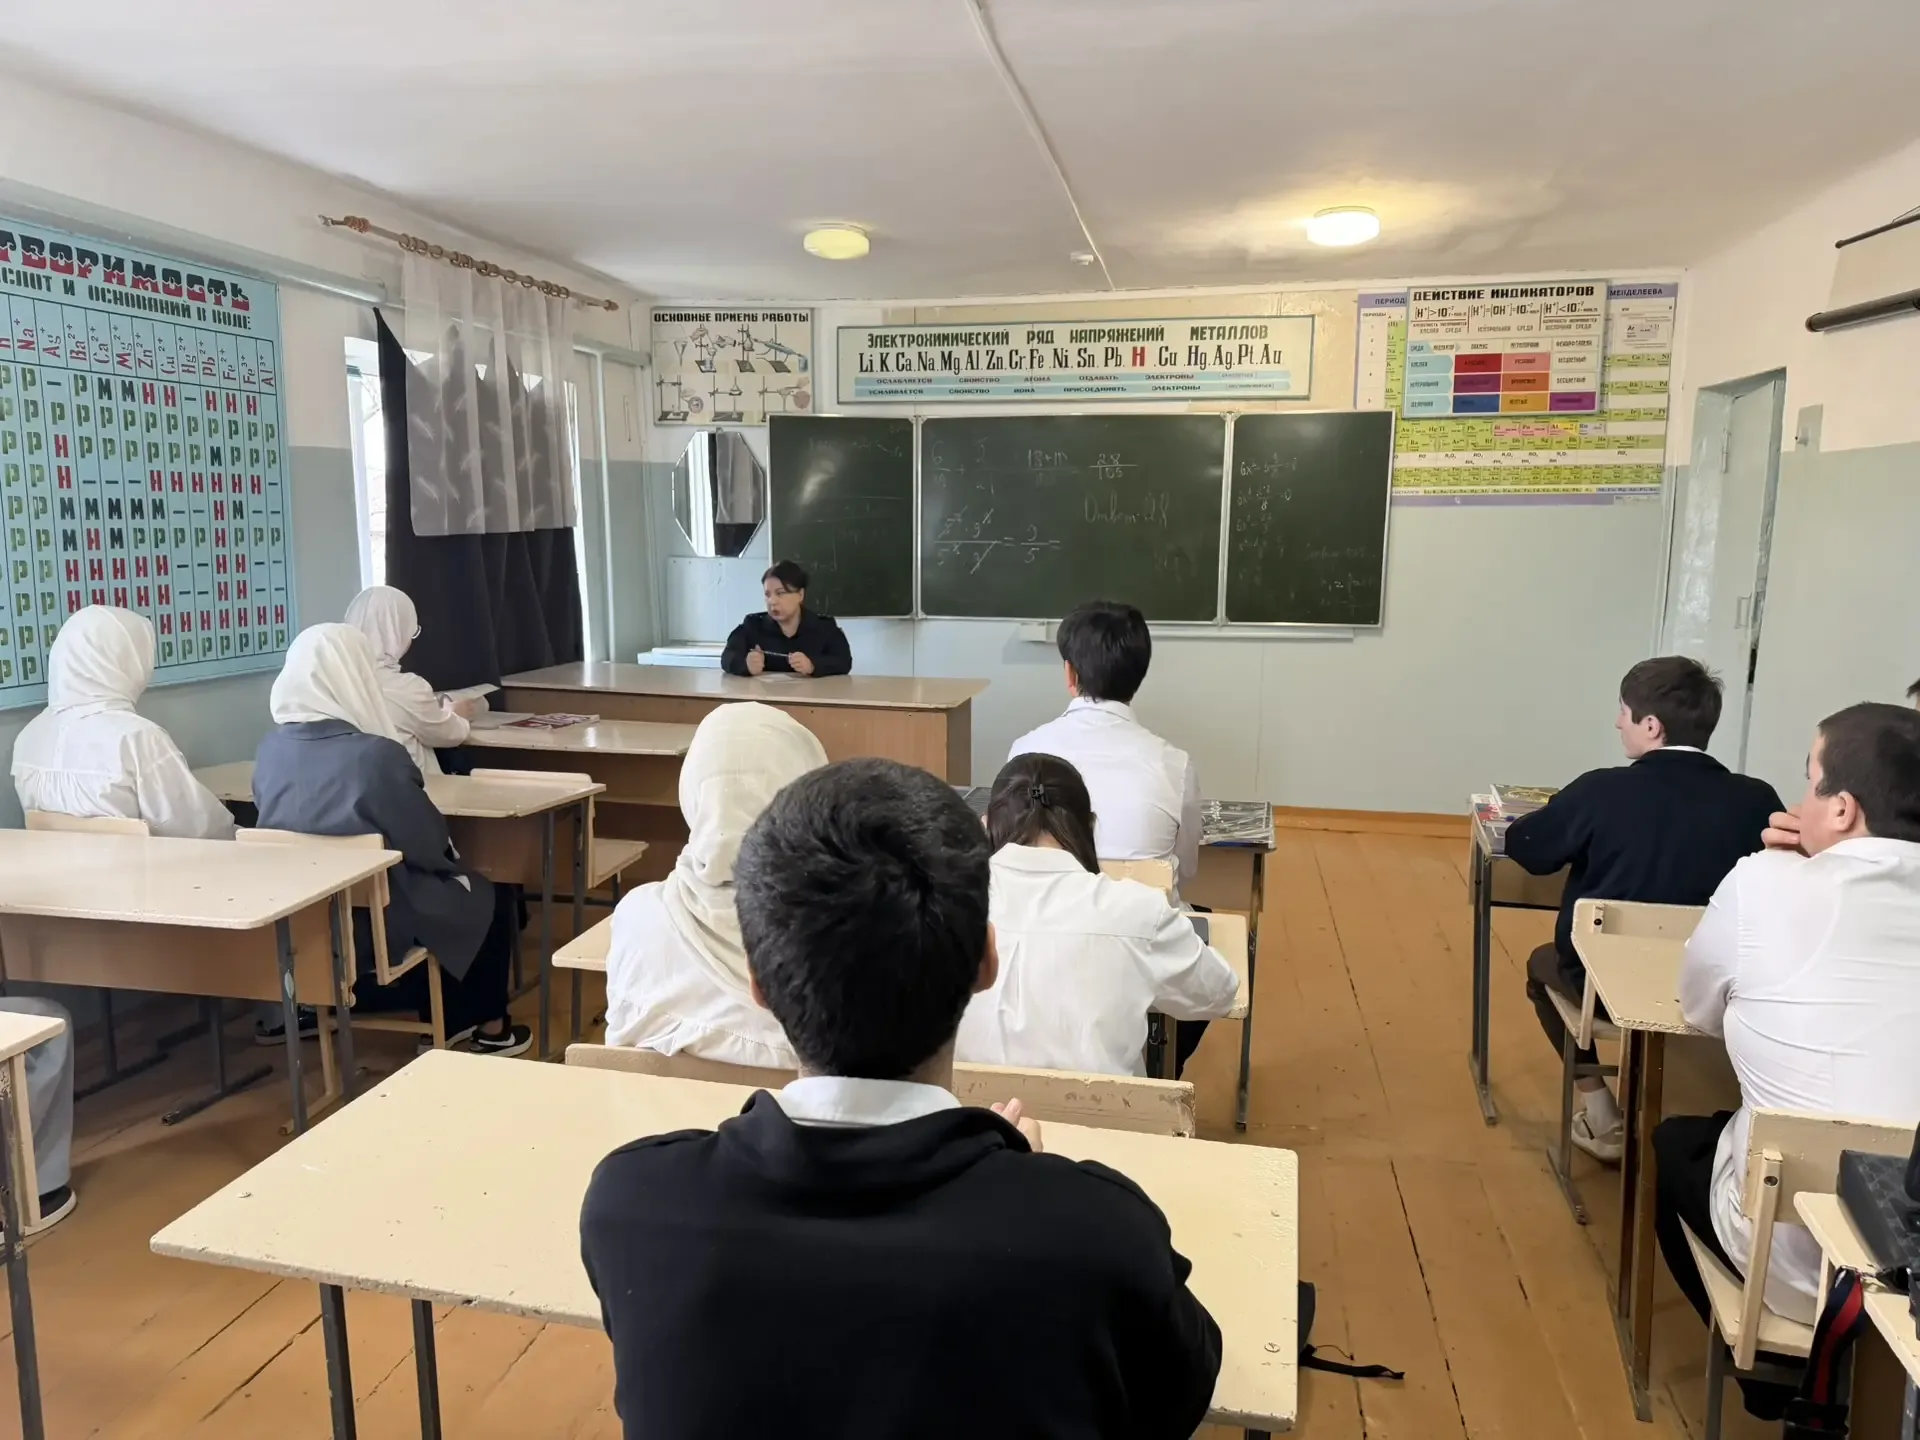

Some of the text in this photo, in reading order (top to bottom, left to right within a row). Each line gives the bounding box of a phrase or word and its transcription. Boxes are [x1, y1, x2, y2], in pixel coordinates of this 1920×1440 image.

[0, 266, 52, 293] СЛОТ
[62, 278, 76, 296] И
[88, 284, 191, 319] ОСНОВАНИЙ
[197, 307, 206, 322] В
[1413, 286, 1595, 301] ДЕЙСТВИЕ ИНДИКАТОРОВ
[762, 312, 809, 322] РАБОТЫ
[867, 325, 1268, 348] ЭЛЕКТРОХИМИЧЕСКИЙ РЯД НАПРЯЖЕНИЙ МЕТАЛЛОВ
